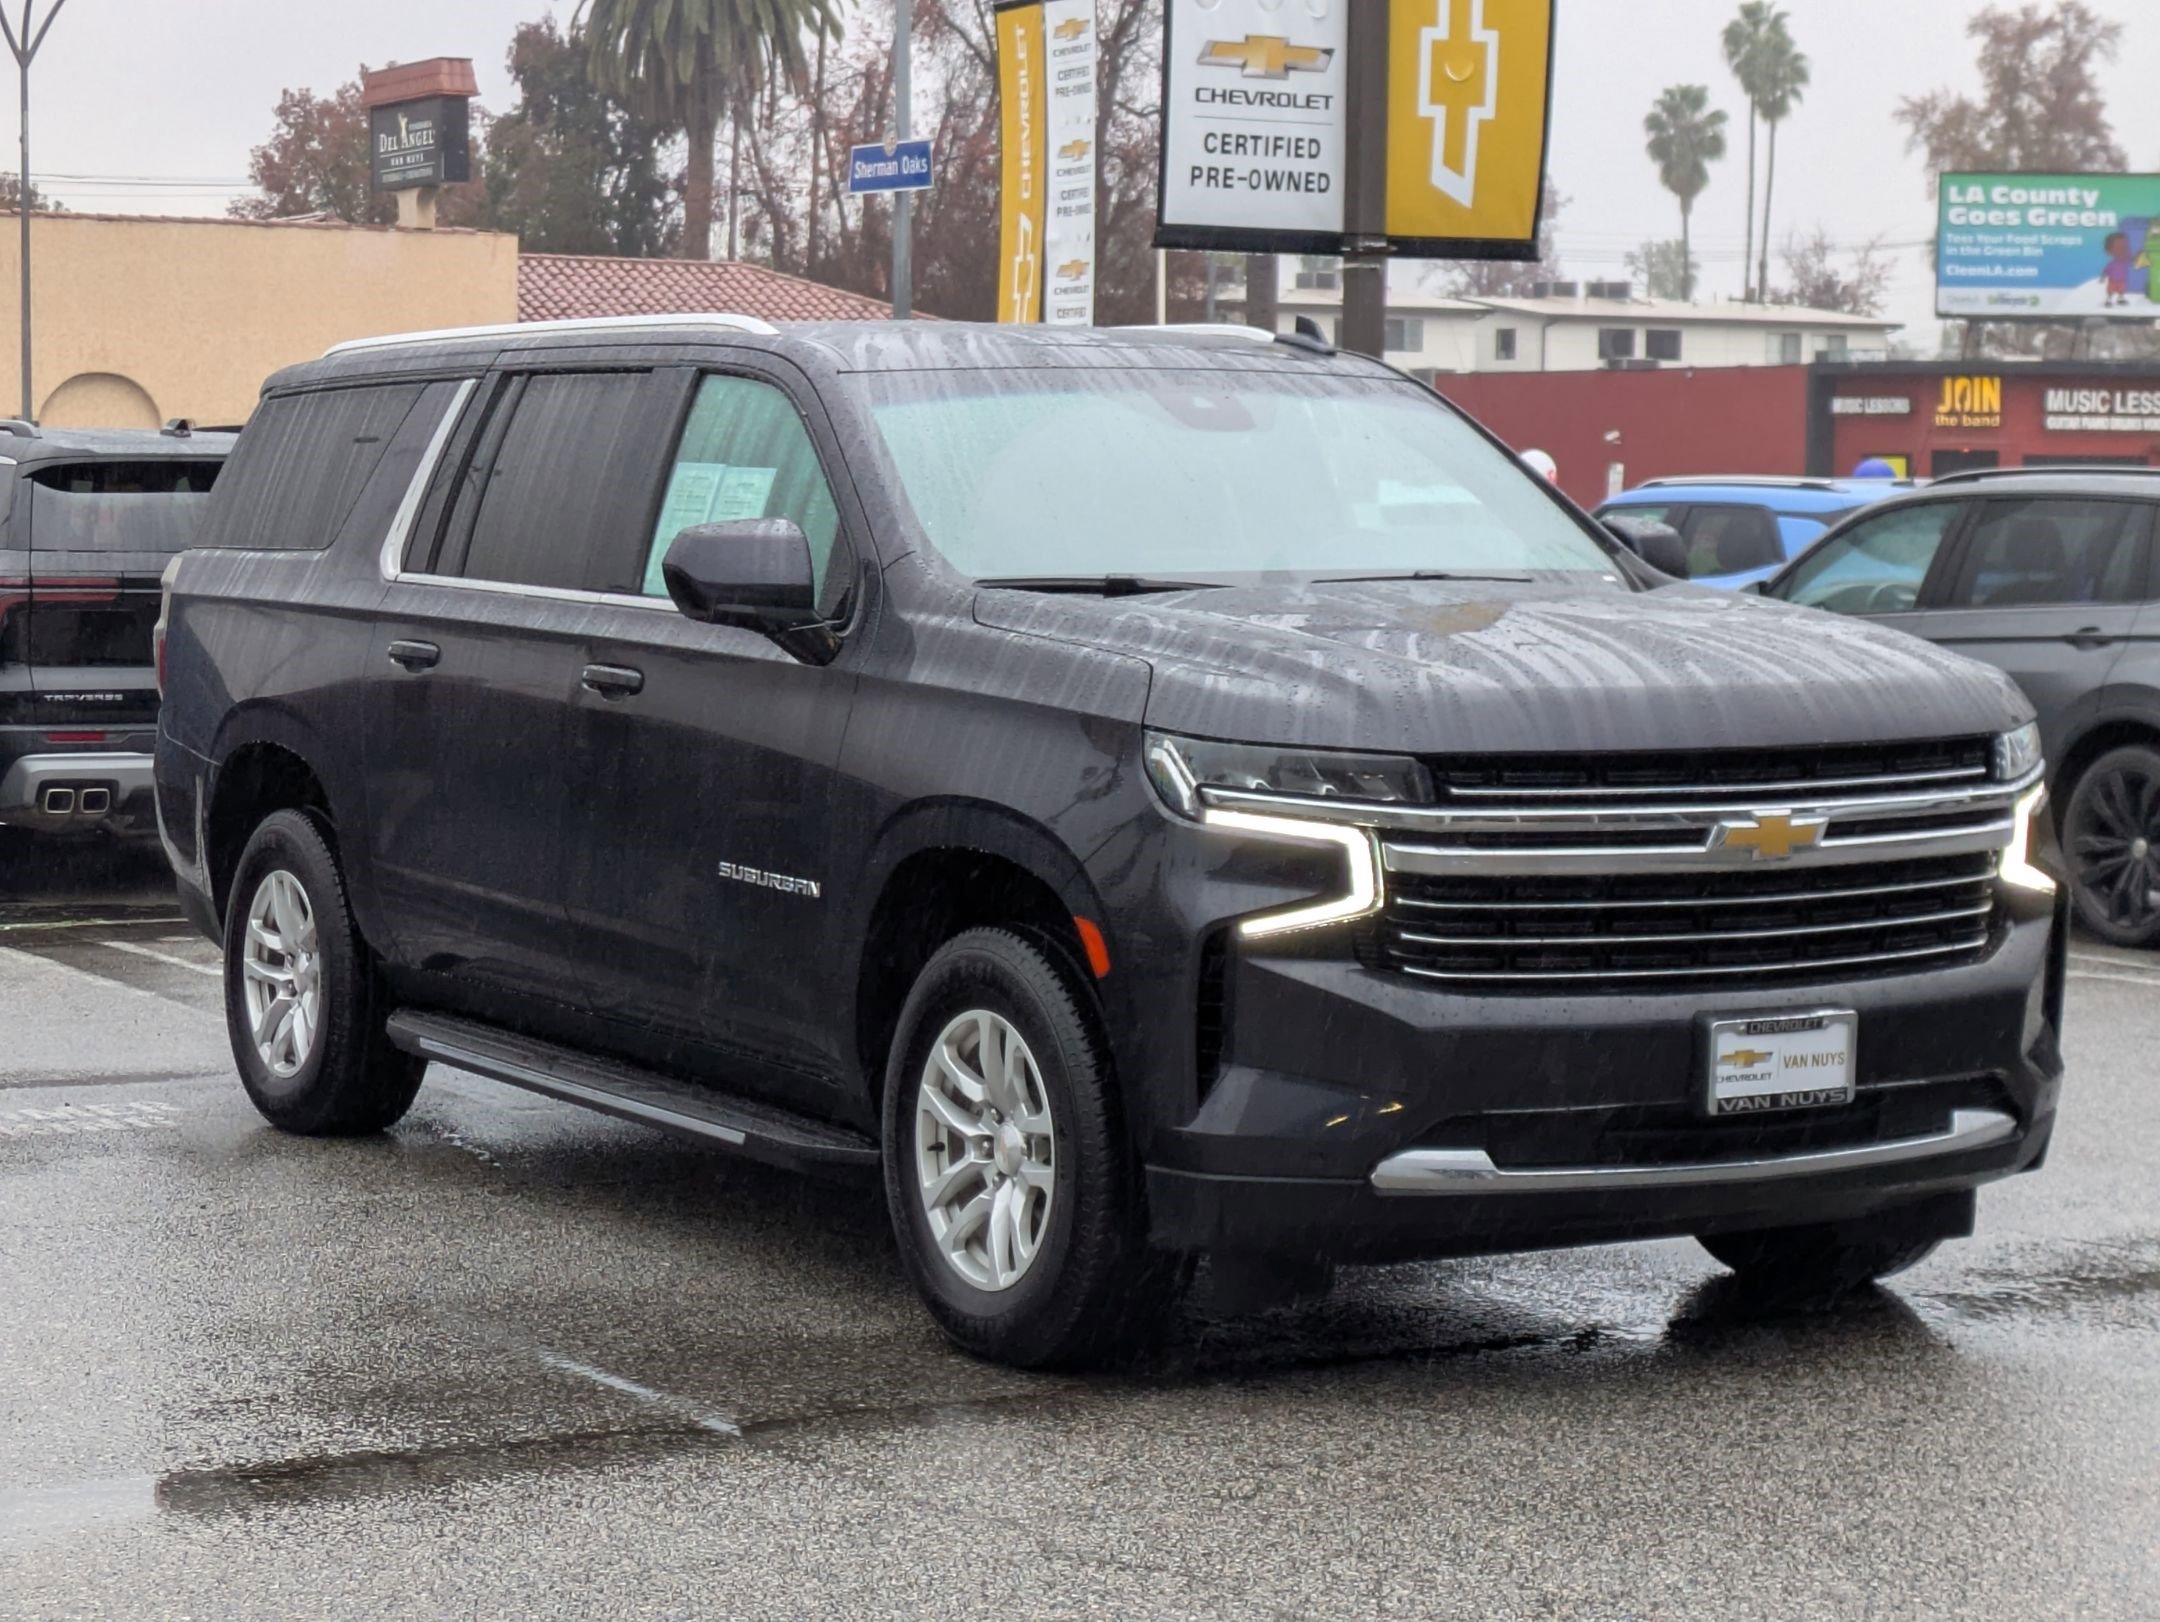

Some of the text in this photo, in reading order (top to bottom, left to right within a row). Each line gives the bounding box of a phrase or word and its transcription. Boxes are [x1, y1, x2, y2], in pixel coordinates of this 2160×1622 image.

[1194, 87, 1334, 111] CHEVROLET
[1015, 24, 1032, 200] CHEVROLET
[379, 130, 435, 153] DEL ANGEL
[1203, 132, 1321, 160] CERTIFIED
[854, 155, 928, 179] Sherman Oaks
[1190, 166, 1331, 194] PRE-OWNED
[1948, 185, 2099, 208] LA County
[1948, 207, 2117, 228] Goes Green
[1983, 246, 2020, 256] Green
[2023, 246, 2044, 257] Bin
[1945, 264, 2039, 277] CleanLA.com
[1936, 376, 2001, 413] JOIN
[2046, 389, 2111, 413] MUSIC
[1935, 414, 2000, 427] the band
[43, 693, 124, 702] TRAVERSE
[718, 861, 821, 898] SUBURBAN
[1749, 1018, 1819, 1034] CHEVROLET
[1783, 1052, 1845, 1069] VAN NUYS
[1720, 1088, 1847, 1112] VAN NUYS
